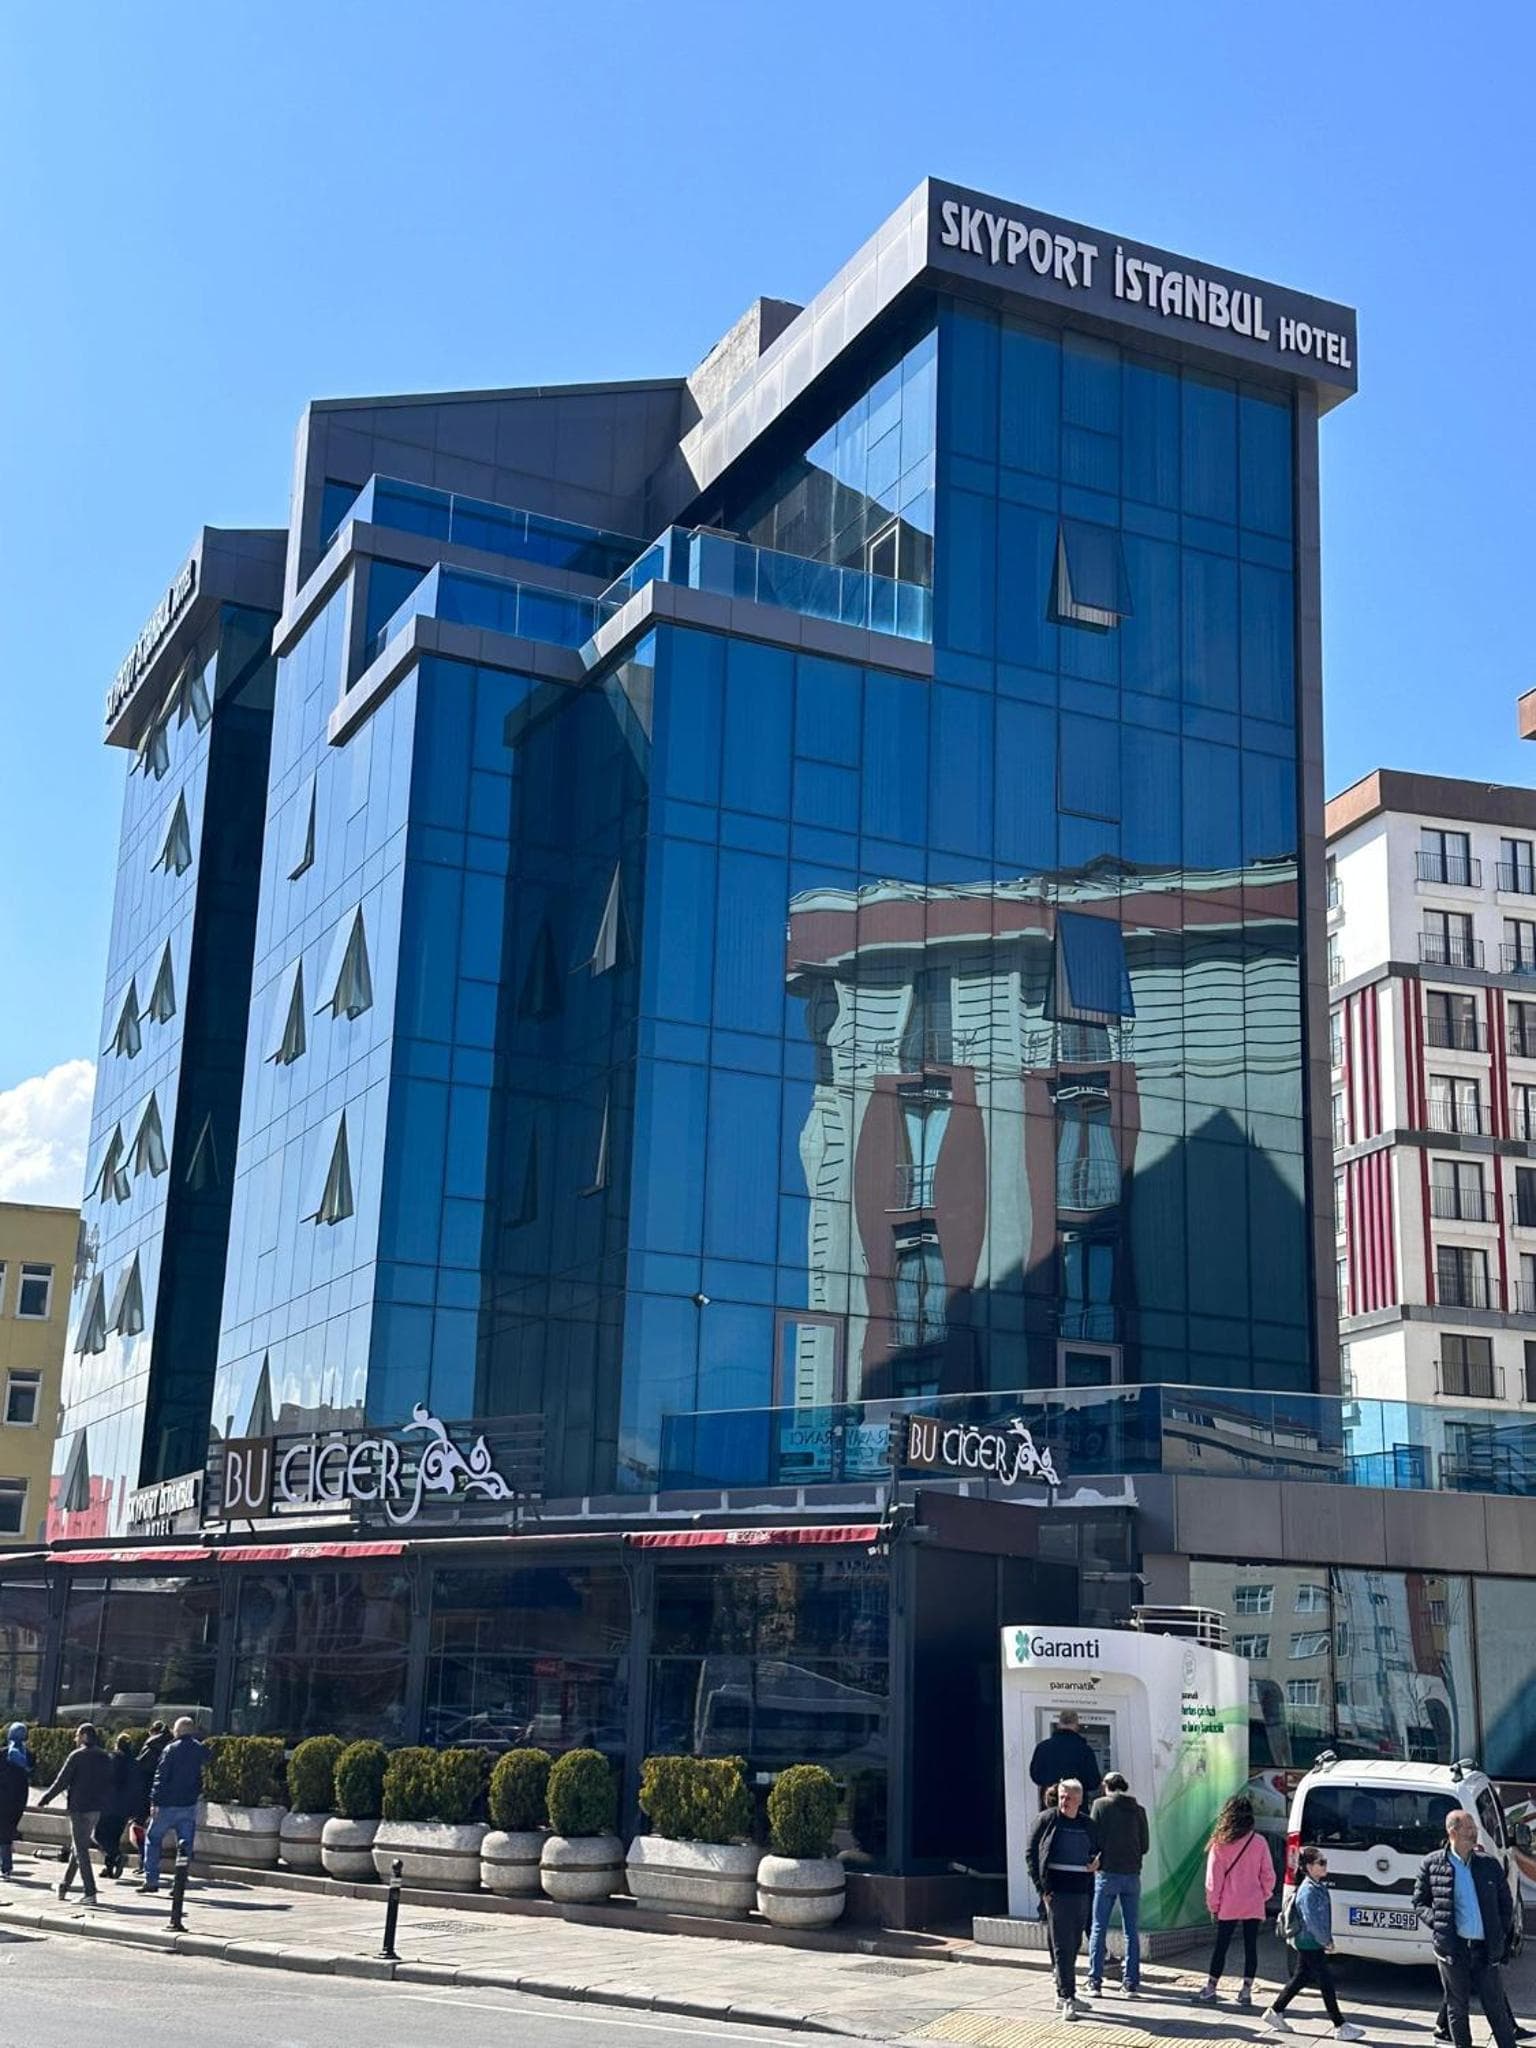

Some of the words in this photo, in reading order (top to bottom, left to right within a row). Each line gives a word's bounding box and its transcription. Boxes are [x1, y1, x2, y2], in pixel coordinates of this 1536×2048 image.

[940, 200, 1099, 290] SKYPORT
[1114, 245, 1270, 342] İSTANBUL
[1280, 316, 1352, 369] HOTEL
[909, 1422, 937, 1463] BU
[224, 1447, 268, 1509] BU
[1031, 1636, 1100, 1659] Garanti
[1357, 1910, 1369, 1922] 34
[1389, 1912, 1416, 1927] 5096
